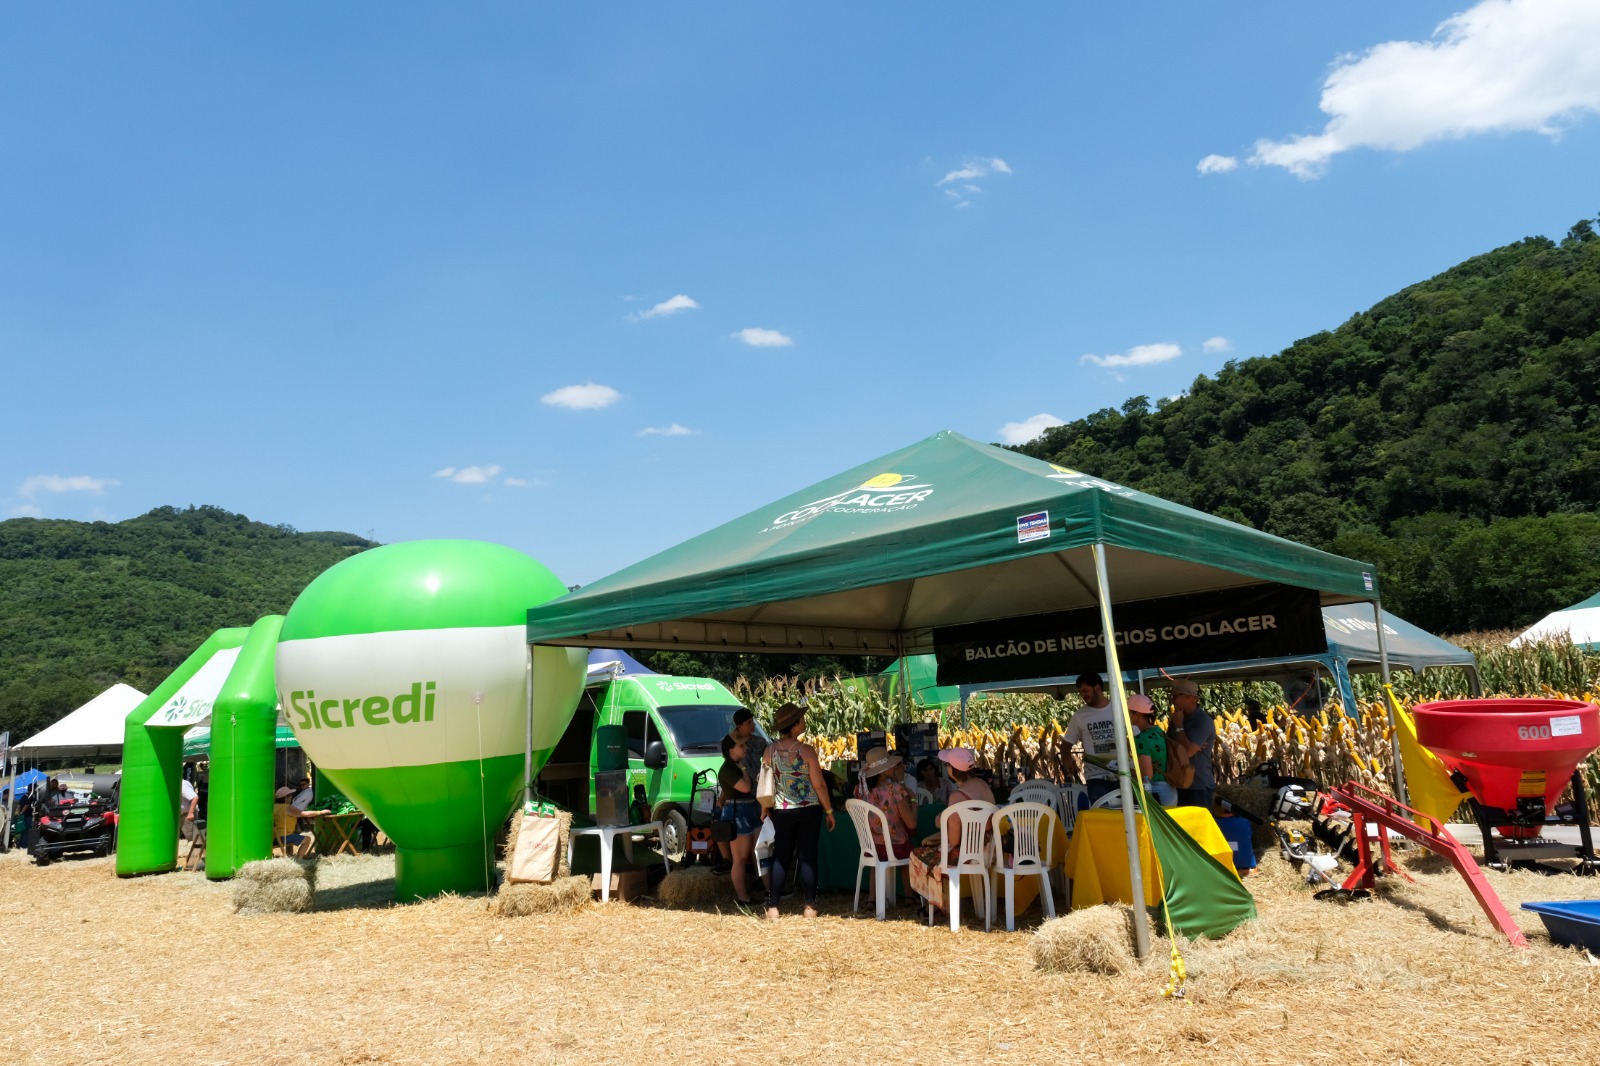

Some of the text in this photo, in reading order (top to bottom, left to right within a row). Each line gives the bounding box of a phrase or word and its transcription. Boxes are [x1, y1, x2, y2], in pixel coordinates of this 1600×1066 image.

[773, 489, 934, 525] COOLACER
[965, 639, 1031, 661] BALCÃO
[1034, 638, 1058, 654] DE
[1160, 614, 1278, 641] COOLACER
[673, 681, 715, 691] Sicredi
[290, 681, 437, 730] Sicredi
[1087, 720, 1114, 731] CAMP
[1517, 725, 1551, 740] 600
